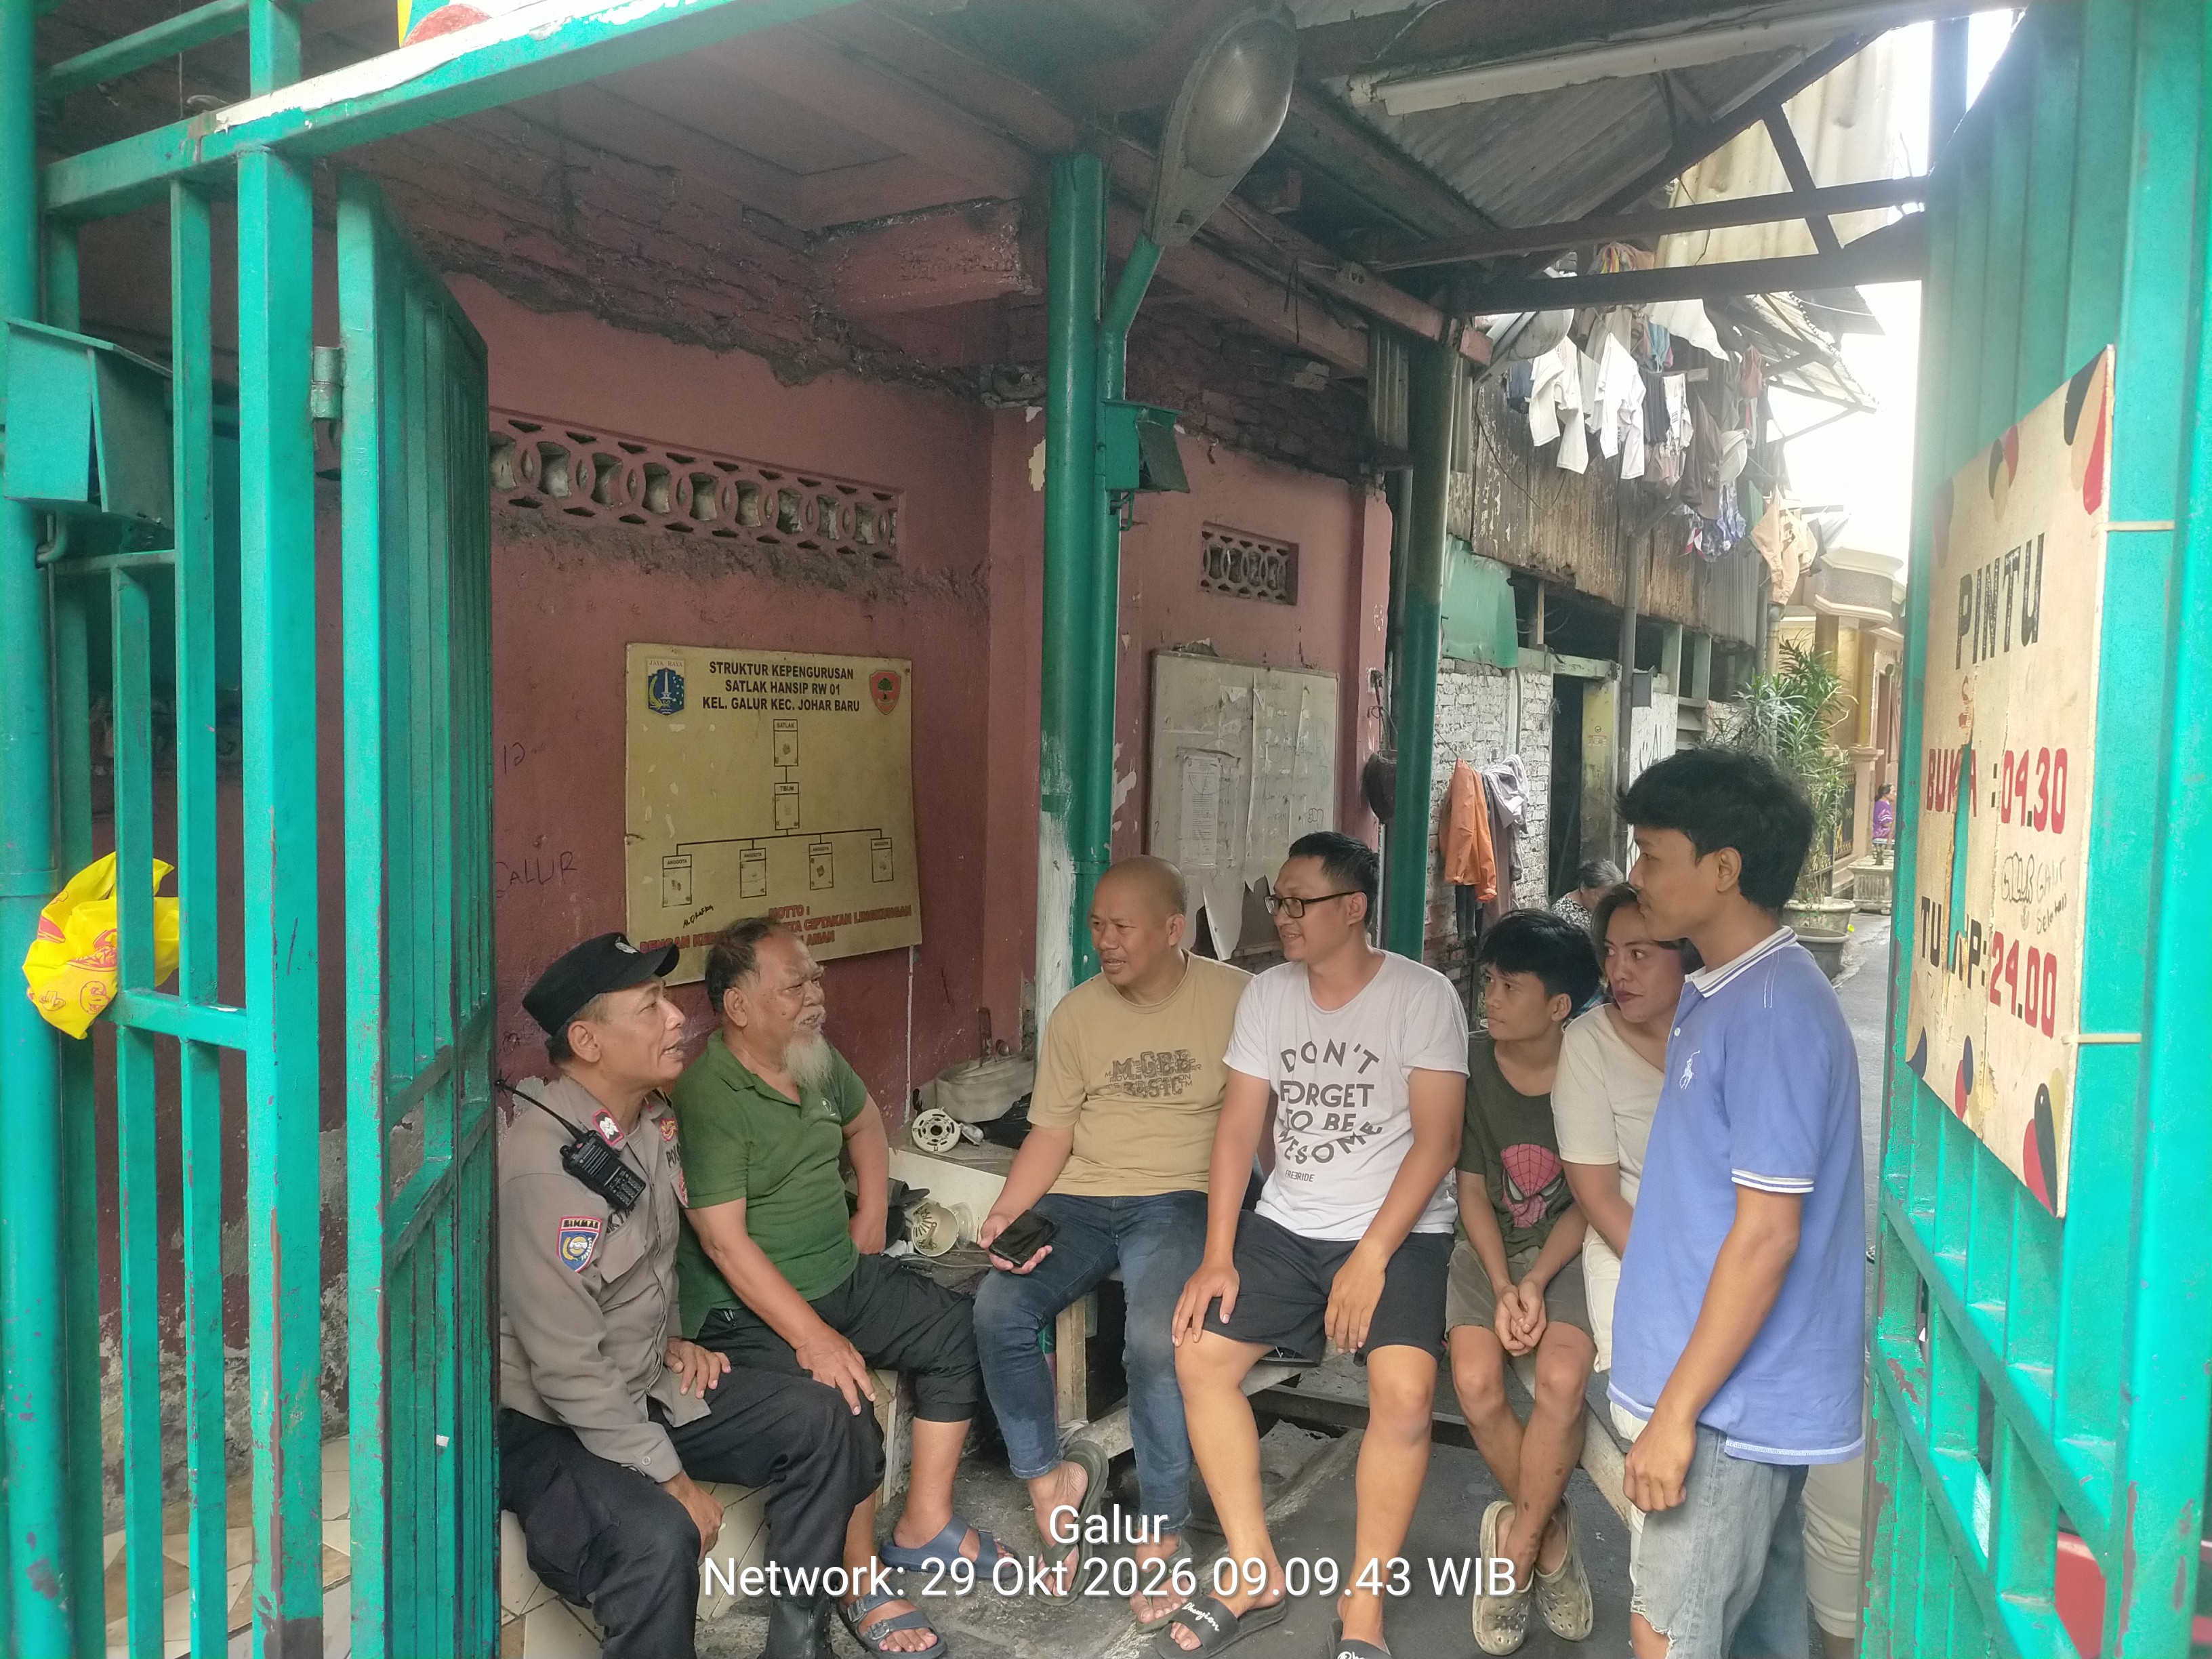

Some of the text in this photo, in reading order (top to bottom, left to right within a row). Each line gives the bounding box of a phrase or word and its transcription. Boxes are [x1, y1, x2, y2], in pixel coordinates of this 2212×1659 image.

[1955, 533, 2045, 670] PINTU
[710, 661, 853, 679] STRUKTUR KEPENGURUSAN
[725, 680, 840, 695] SATLAK HANSIP RW 01
[703, 697, 860, 712] KEL. GALUR KEC. JOHAR BARU
[804, 912, 851, 931] CIPTAKAN
[854, 905, 912, 924] LINGKUNGAN
[806, 930, 835, 946] AMAN
[1281, 1038, 1380, 1074] DON'T
[1279, 1080, 1374, 1107] FORGET
[1286, 1108, 1357, 1132] TO BE
